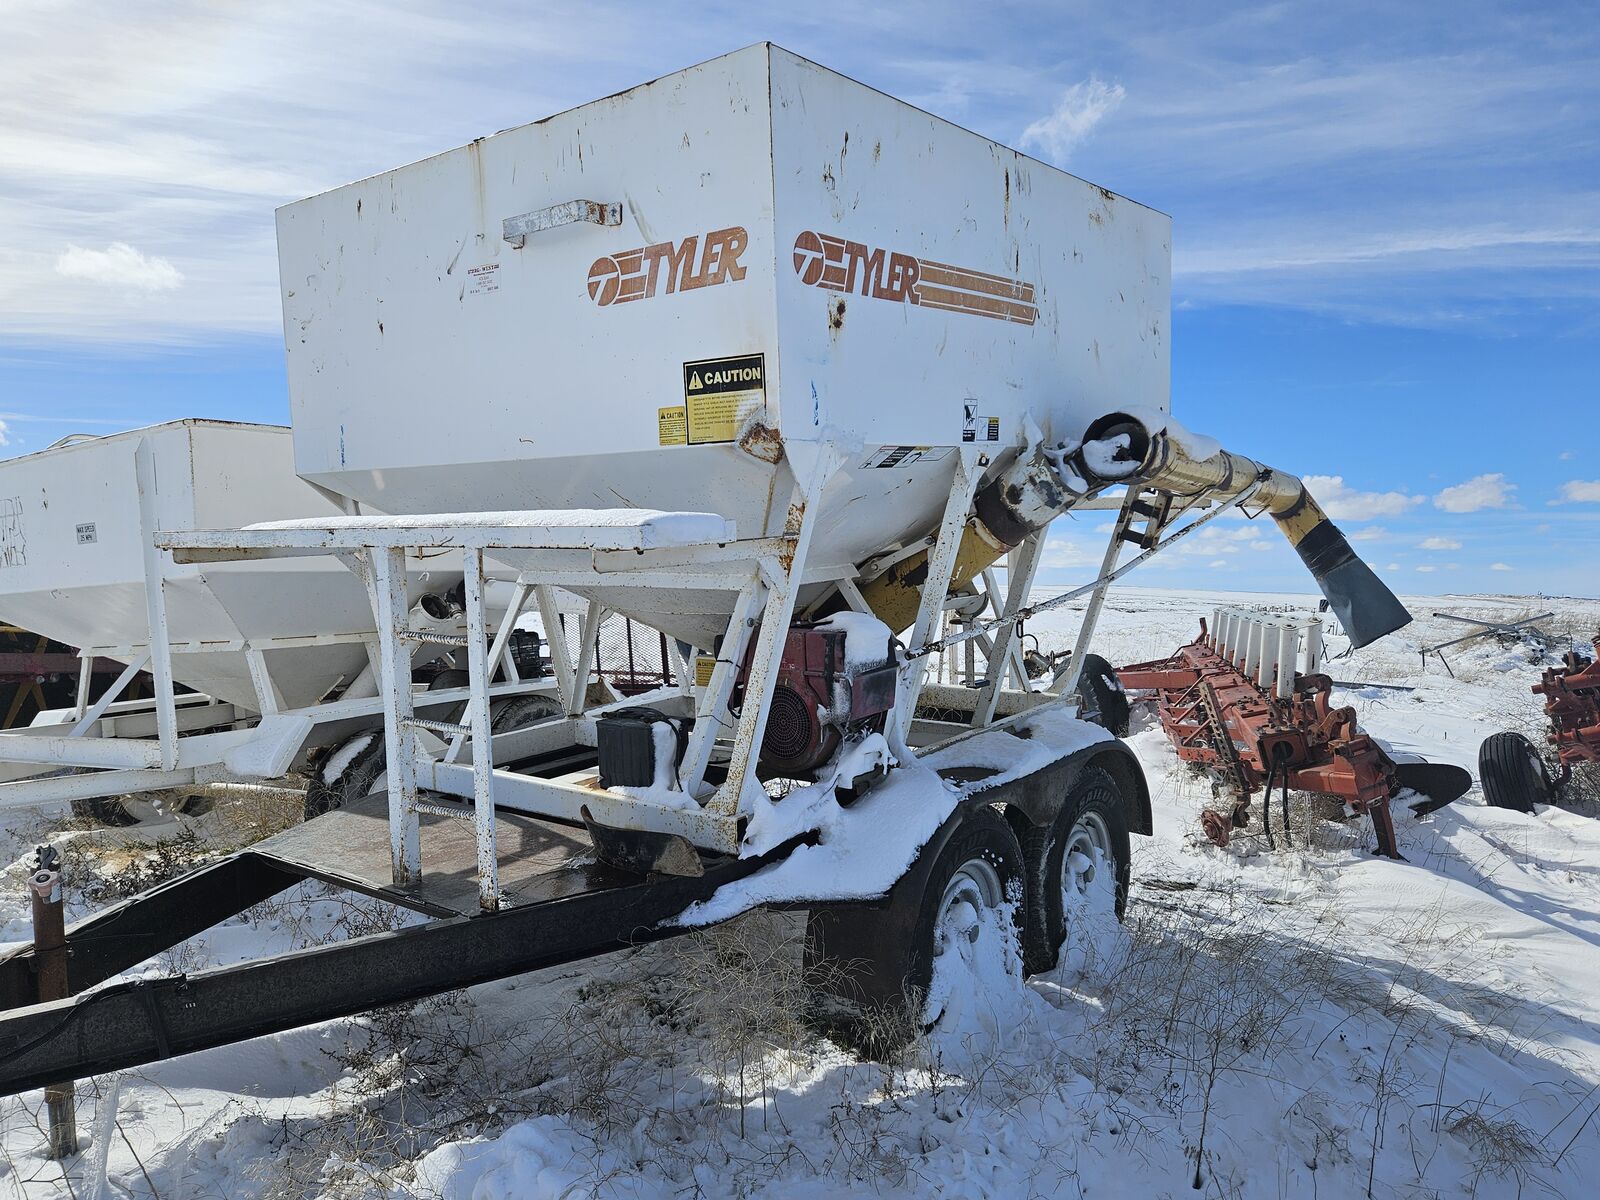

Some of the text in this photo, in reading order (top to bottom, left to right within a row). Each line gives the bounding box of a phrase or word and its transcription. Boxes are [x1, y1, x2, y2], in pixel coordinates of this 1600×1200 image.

[643, 226, 749, 299] TYLER
[844, 240, 921, 306] TYLER
[704, 366, 761, 386] CAUTION
[666, 411, 684, 420] CAUTION
[84, 525, 95, 533] SPEED
